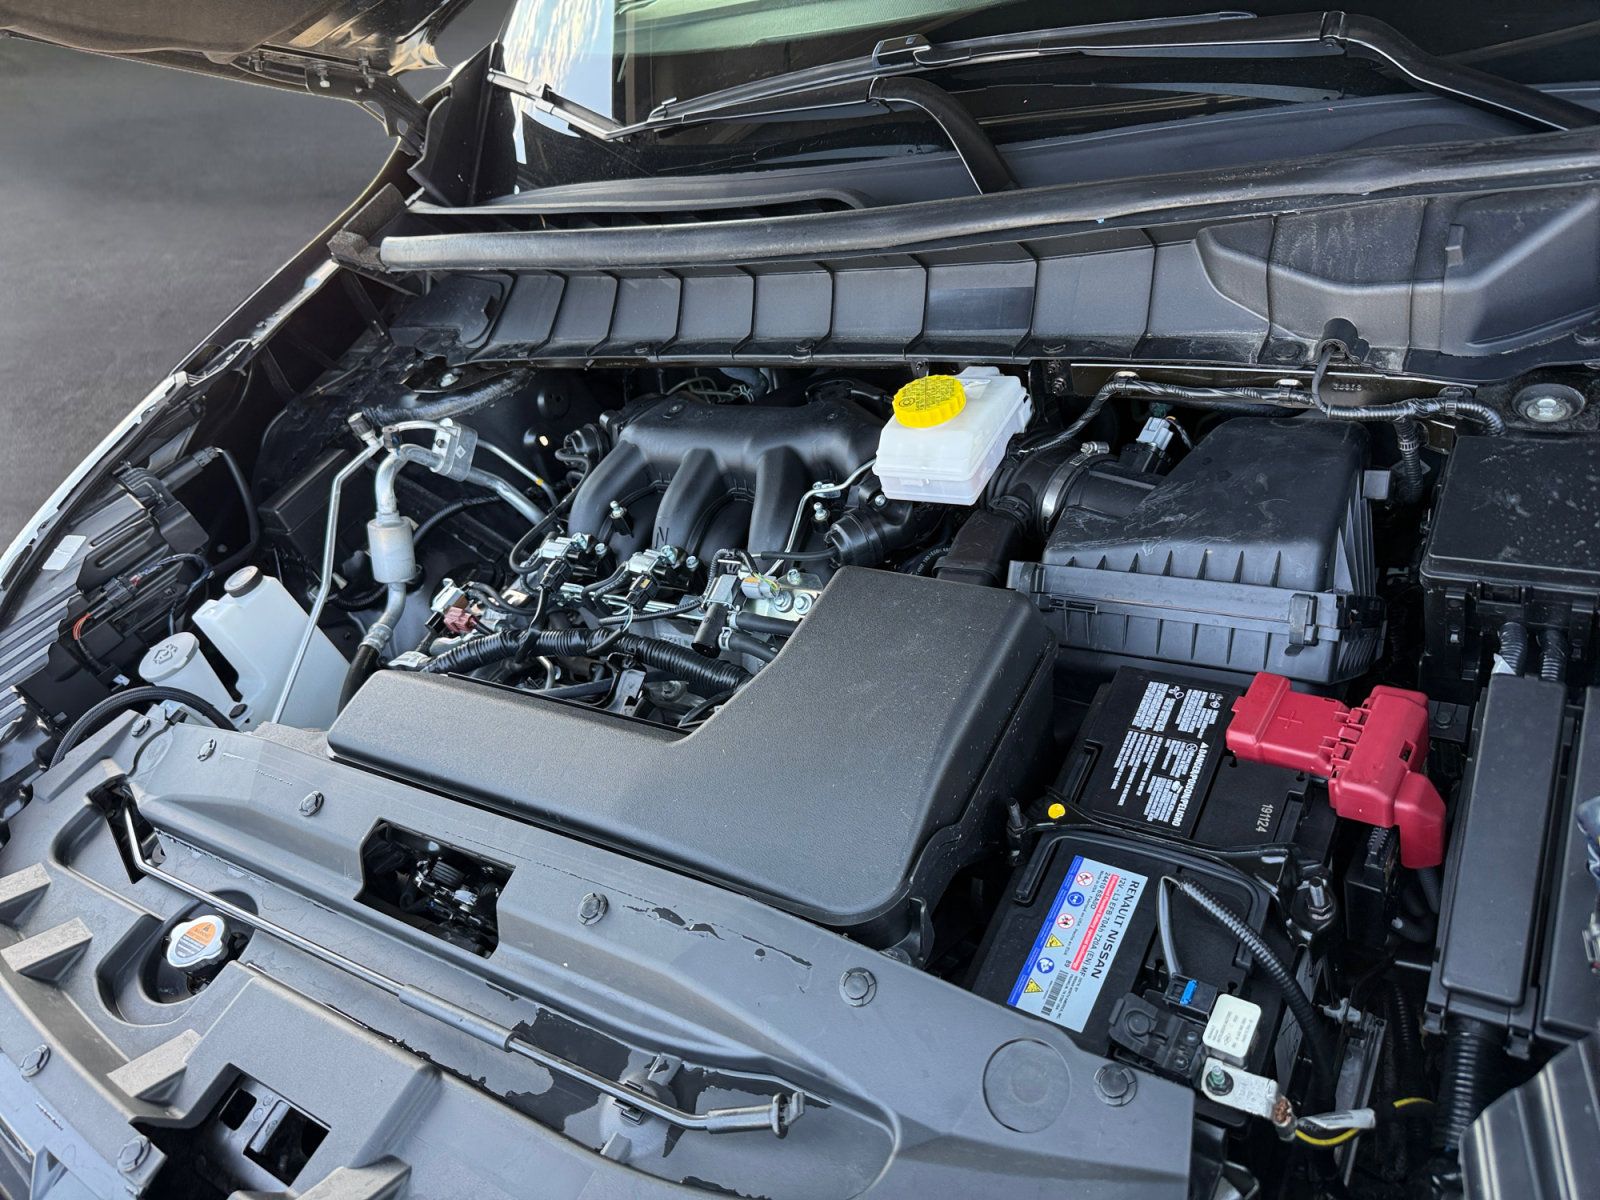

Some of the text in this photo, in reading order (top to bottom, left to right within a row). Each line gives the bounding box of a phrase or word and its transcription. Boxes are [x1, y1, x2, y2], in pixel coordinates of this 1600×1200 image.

[1170, 748, 1207, 827] DANGER/POISON/PELIGRO
[1256, 804, 1273, 833] 191124
[1117, 876, 1126, 888] 12V
[1111, 892, 1119, 901] L3
[1105, 901, 1115, 915] EFB
[1090, 880, 1140, 979] RENAULT NISSAN
[1097, 915, 1109, 933] 70Ah
[1090, 933, 1101, 949] 720A
[1082, 949, 1094, 965] (EN)
[1078, 965, 1087, 977] MF
